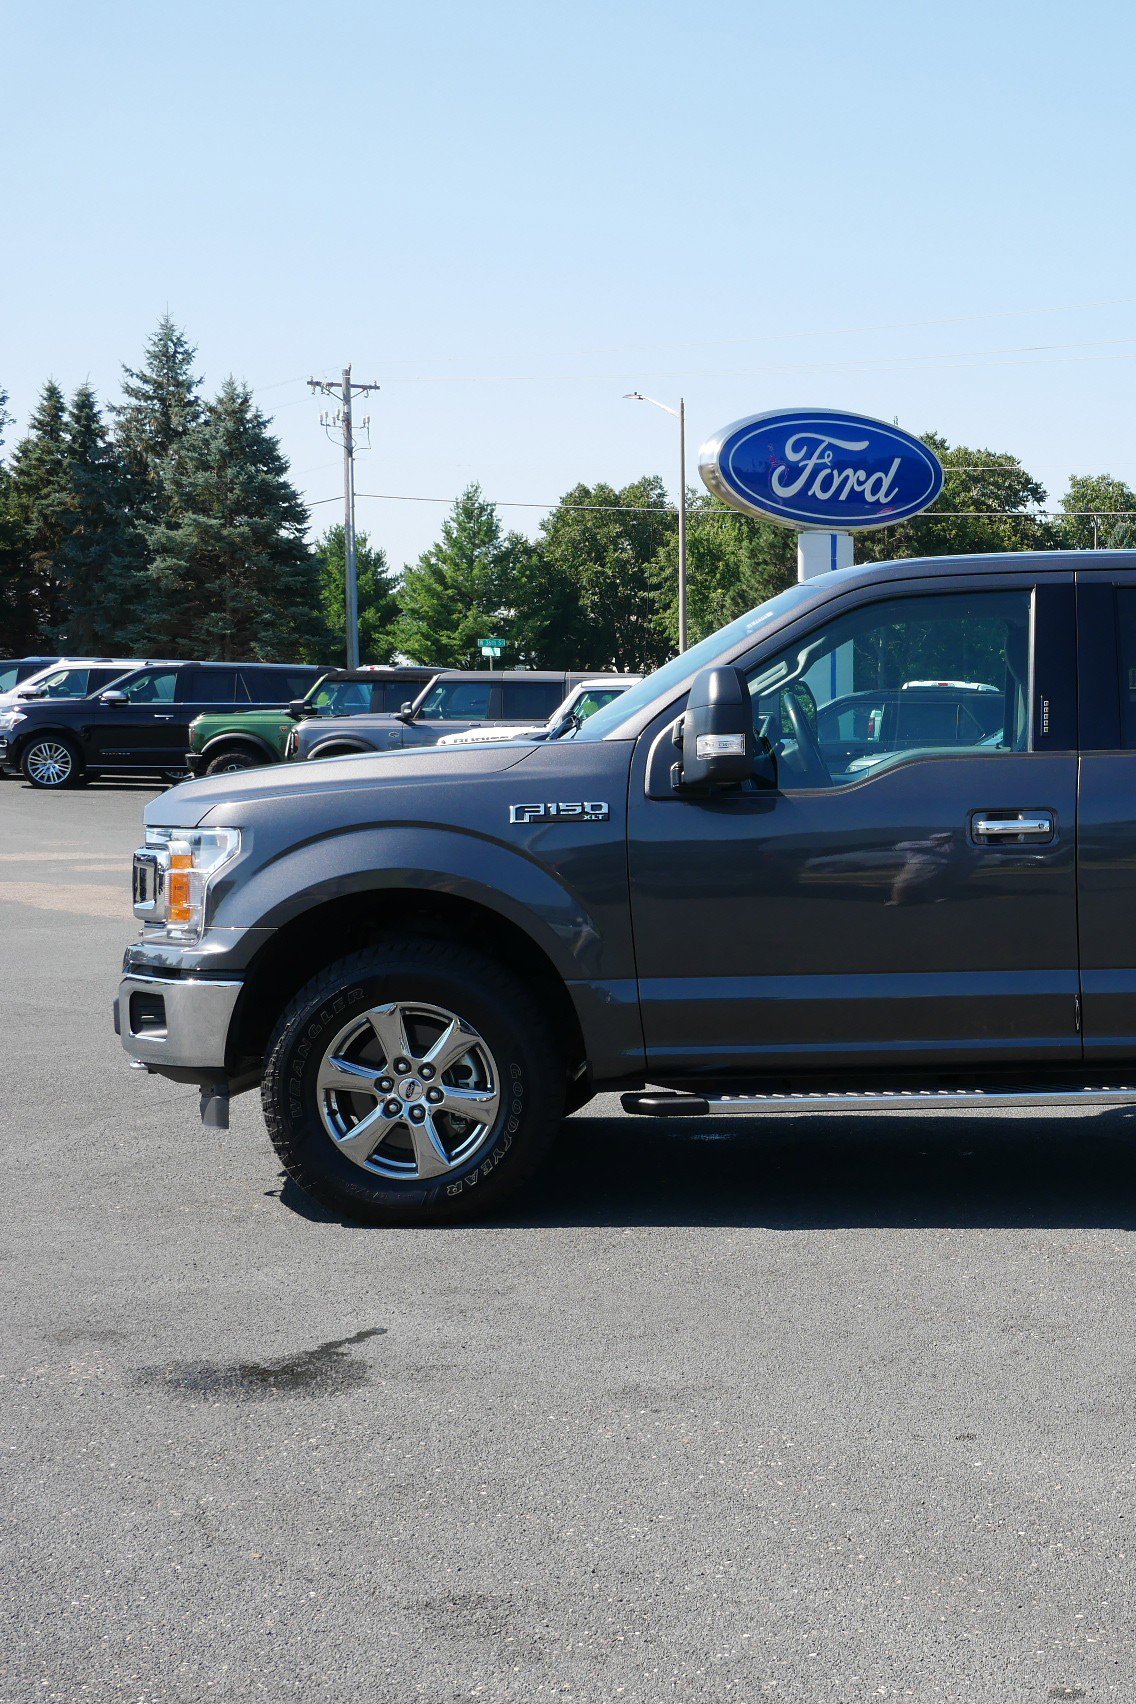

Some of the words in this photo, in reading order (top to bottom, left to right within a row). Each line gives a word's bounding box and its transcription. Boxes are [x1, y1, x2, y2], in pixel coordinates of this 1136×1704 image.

[771, 432, 901, 504] Ford
[289, 987, 365, 1118] WRANGLER
[447, 1063, 523, 1196] GOODYEAR
